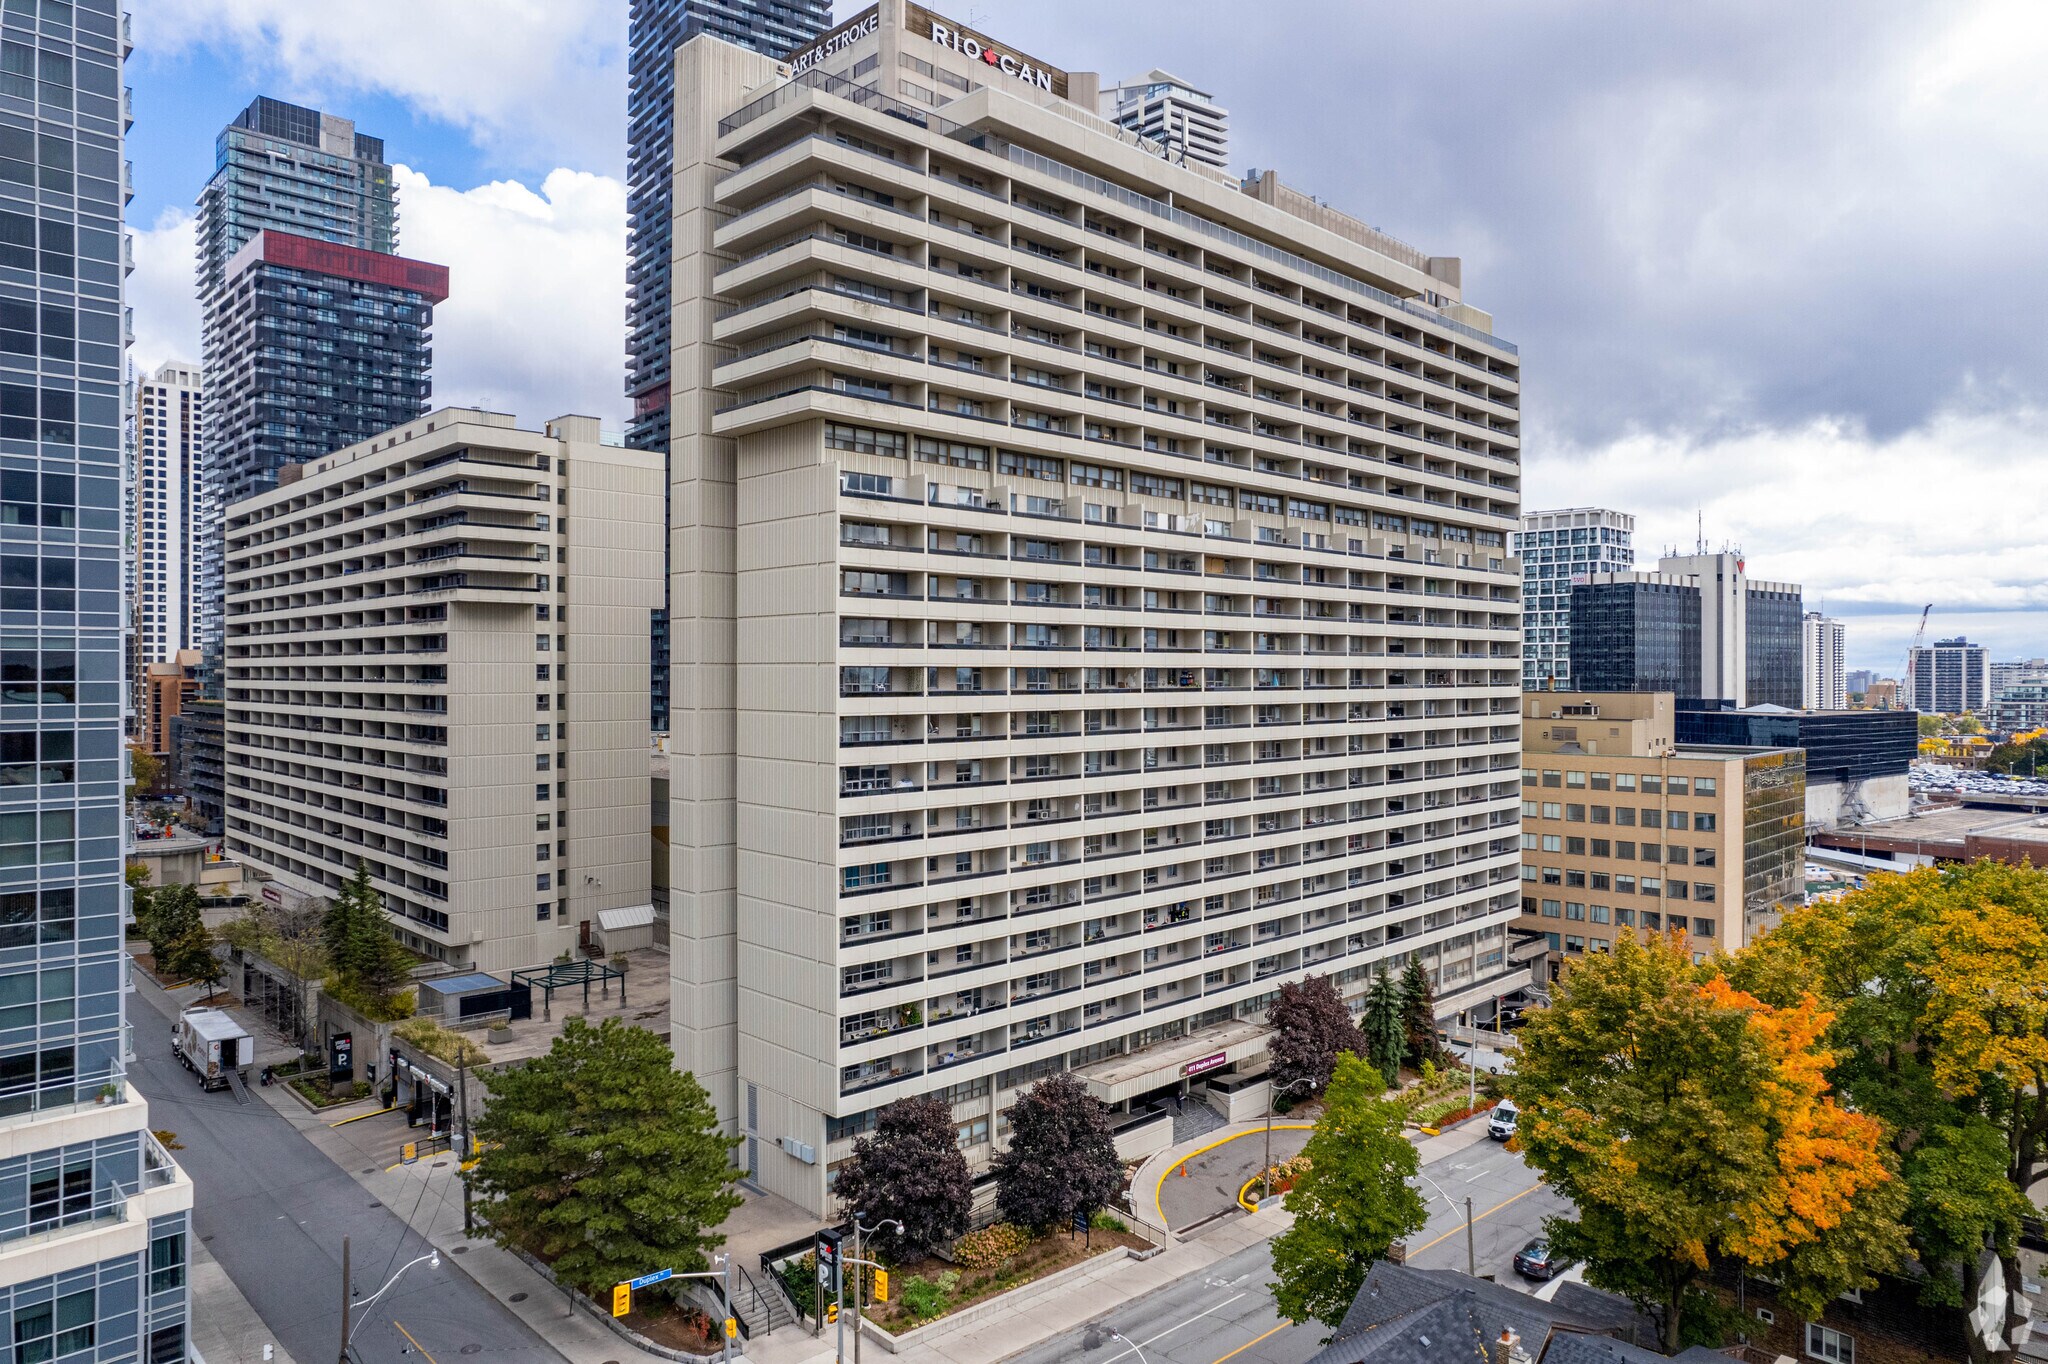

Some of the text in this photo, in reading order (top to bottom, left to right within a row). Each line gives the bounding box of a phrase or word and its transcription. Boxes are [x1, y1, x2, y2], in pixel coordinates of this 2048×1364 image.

[932, 22, 1051, 93] RIO CAN
[338, 1053, 347, 1065] P
[1196, 1061, 1209, 1069] Duplex
[819, 1264, 828, 1283] P
[639, 1275, 659, 1285] Duplex
